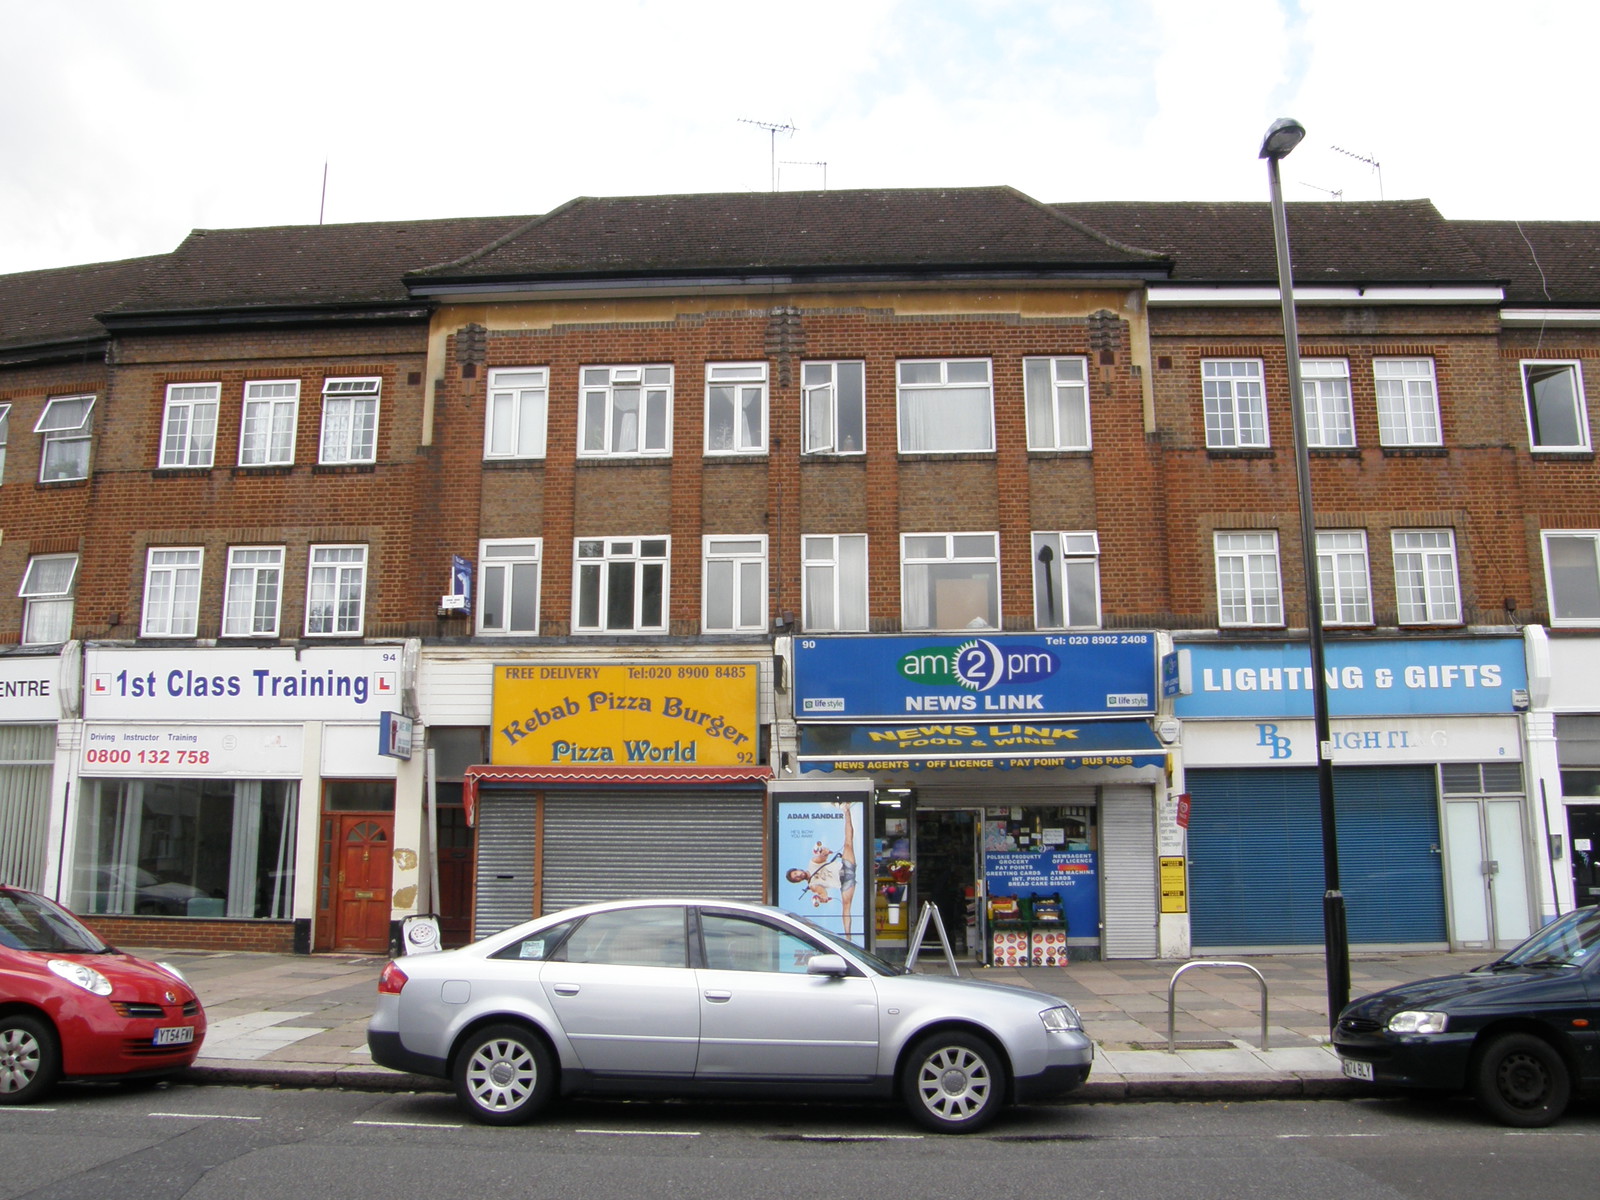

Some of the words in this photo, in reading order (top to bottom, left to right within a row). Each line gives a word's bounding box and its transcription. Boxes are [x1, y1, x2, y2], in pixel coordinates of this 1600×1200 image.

[802, 640, 816, 649] 90
[1045, 637, 1066, 646] Tel:
[1069, 637, 1089, 645] 020
[1092, 636, 1118, 645] 8902
[1121, 635, 1147, 645] 2408
[382, 653, 397, 662] 94
[677, 666, 709, 679] 8900
[715, 666, 746, 679] 8485
[904, 654, 949, 675] am
[967, 650, 986, 678] 2
[1008, 653, 1052, 681] pm
[505, 667, 535, 680] FREE
[540, 667, 601, 679] DELIVERY
[1375, 668, 1394, 689] &
[1404, 664, 1503, 689] GIFTS
[116, 669, 157, 697] 1st
[167, 669, 241, 697] Class
[253, 669, 369, 704] Training
[905, 695, 978, 711] NEWS
[984, 694, 1045, 711] LINK
[500, 695, 581, 747] Kebab
[587, 690, 653, 713] Pizza
[661, 695, 750, 746] Burger
[90, 733, 116, 743] Driving
[123, 733, 160, 742] Instructor
[168, 733, 198, 744] Training
[868, 725, 977, 742] NEWS
[989, 724, 1080, 740] LINK
[898, 738, 963, 748] FOOD
[971, 739, 988, 747] &
[993, 737, 1056, 746] WINE
[86, 748, 132, 764] 0800
[137, 749, 171, 764] 132
[176, 749, 210, 764] 758
[551, 740, 615, 764] Pizza
[623, 739, 698, 764] World
[736, 751, 754, 764] 92
[834, 761, 865, 770] NEWS
[867, 760, 910, 769] AGENTS
[926, 760, 947, 768] OFF
[949, 759, 995, 768] LICENCE
[1010, 758, 1031, 767] PAY
[1033, 757, 1066, 766] POINT
[1081, 756, 1104, 765] BUS
[1105, 756, 1134, 765] PASS
[159, 1028, 180, 1043] YT54
